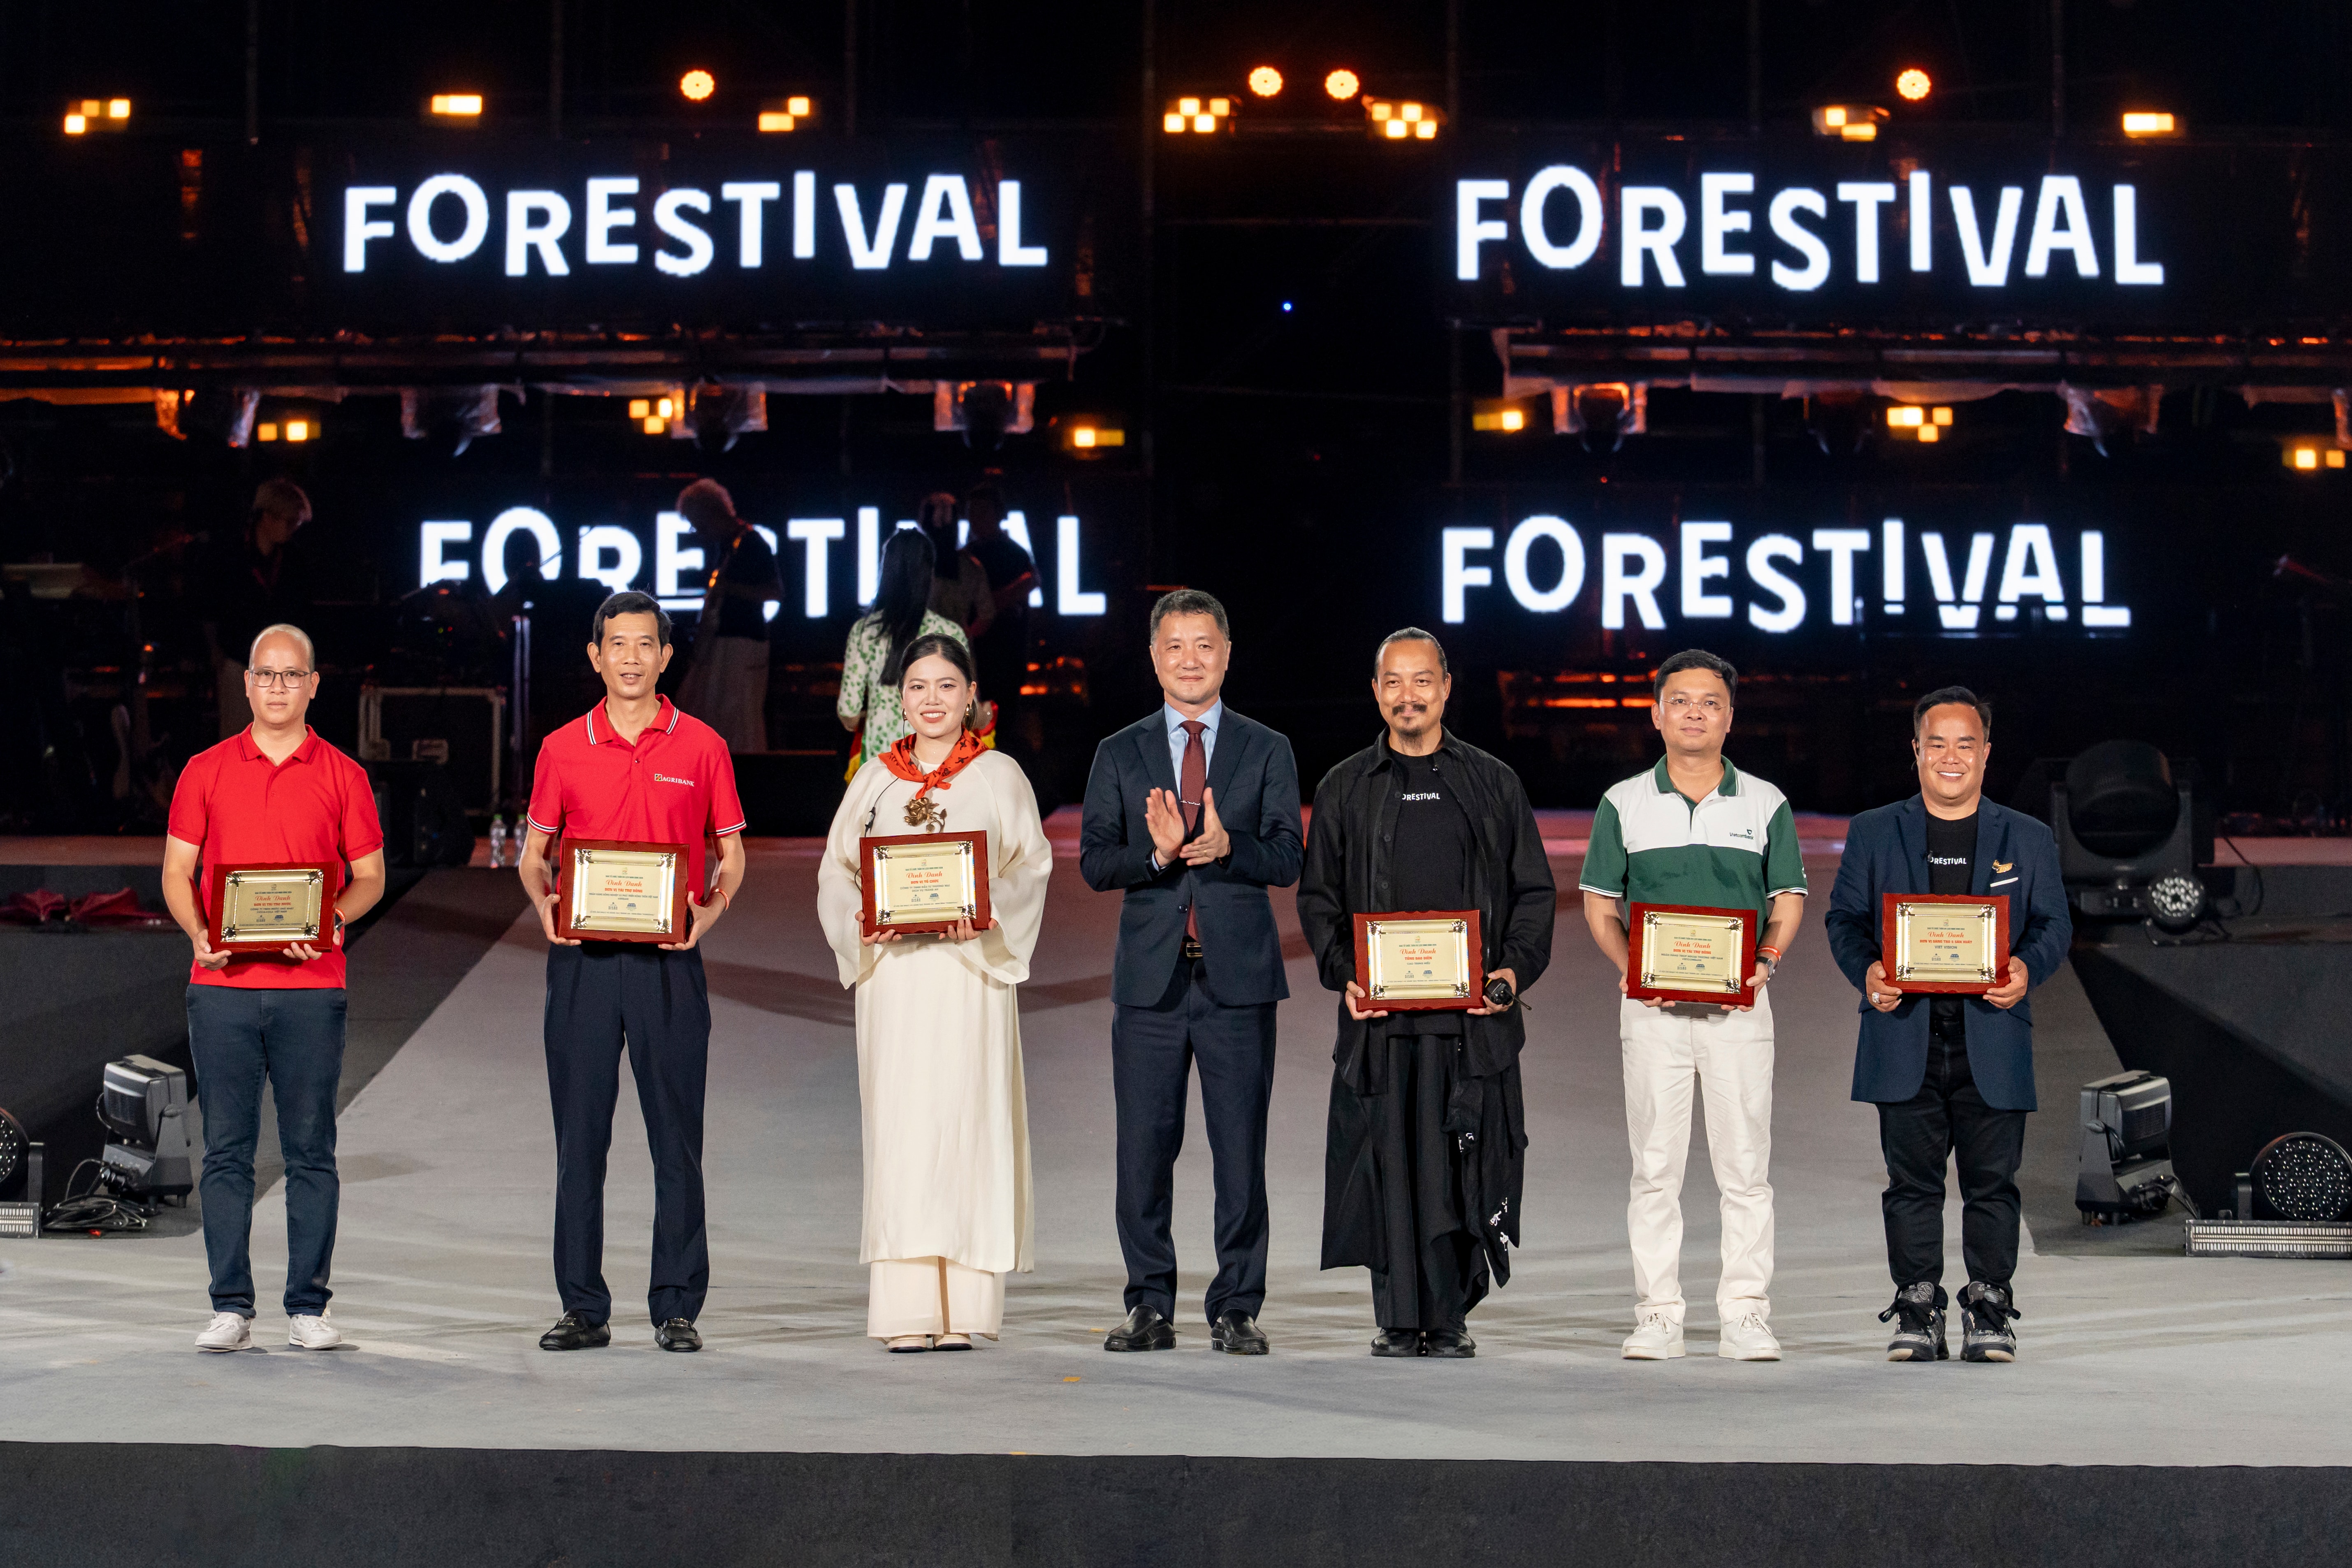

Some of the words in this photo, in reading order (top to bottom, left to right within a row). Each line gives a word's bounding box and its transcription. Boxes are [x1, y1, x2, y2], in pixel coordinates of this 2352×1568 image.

[344, 171, 1048, 276] FORESTIVAL
[1457, 165, 2164, 291] FORESTIVAL
[1442, 515, 2132, 633] FORESTIVAL
[662, 777, 694, 786] AGRIBANK
